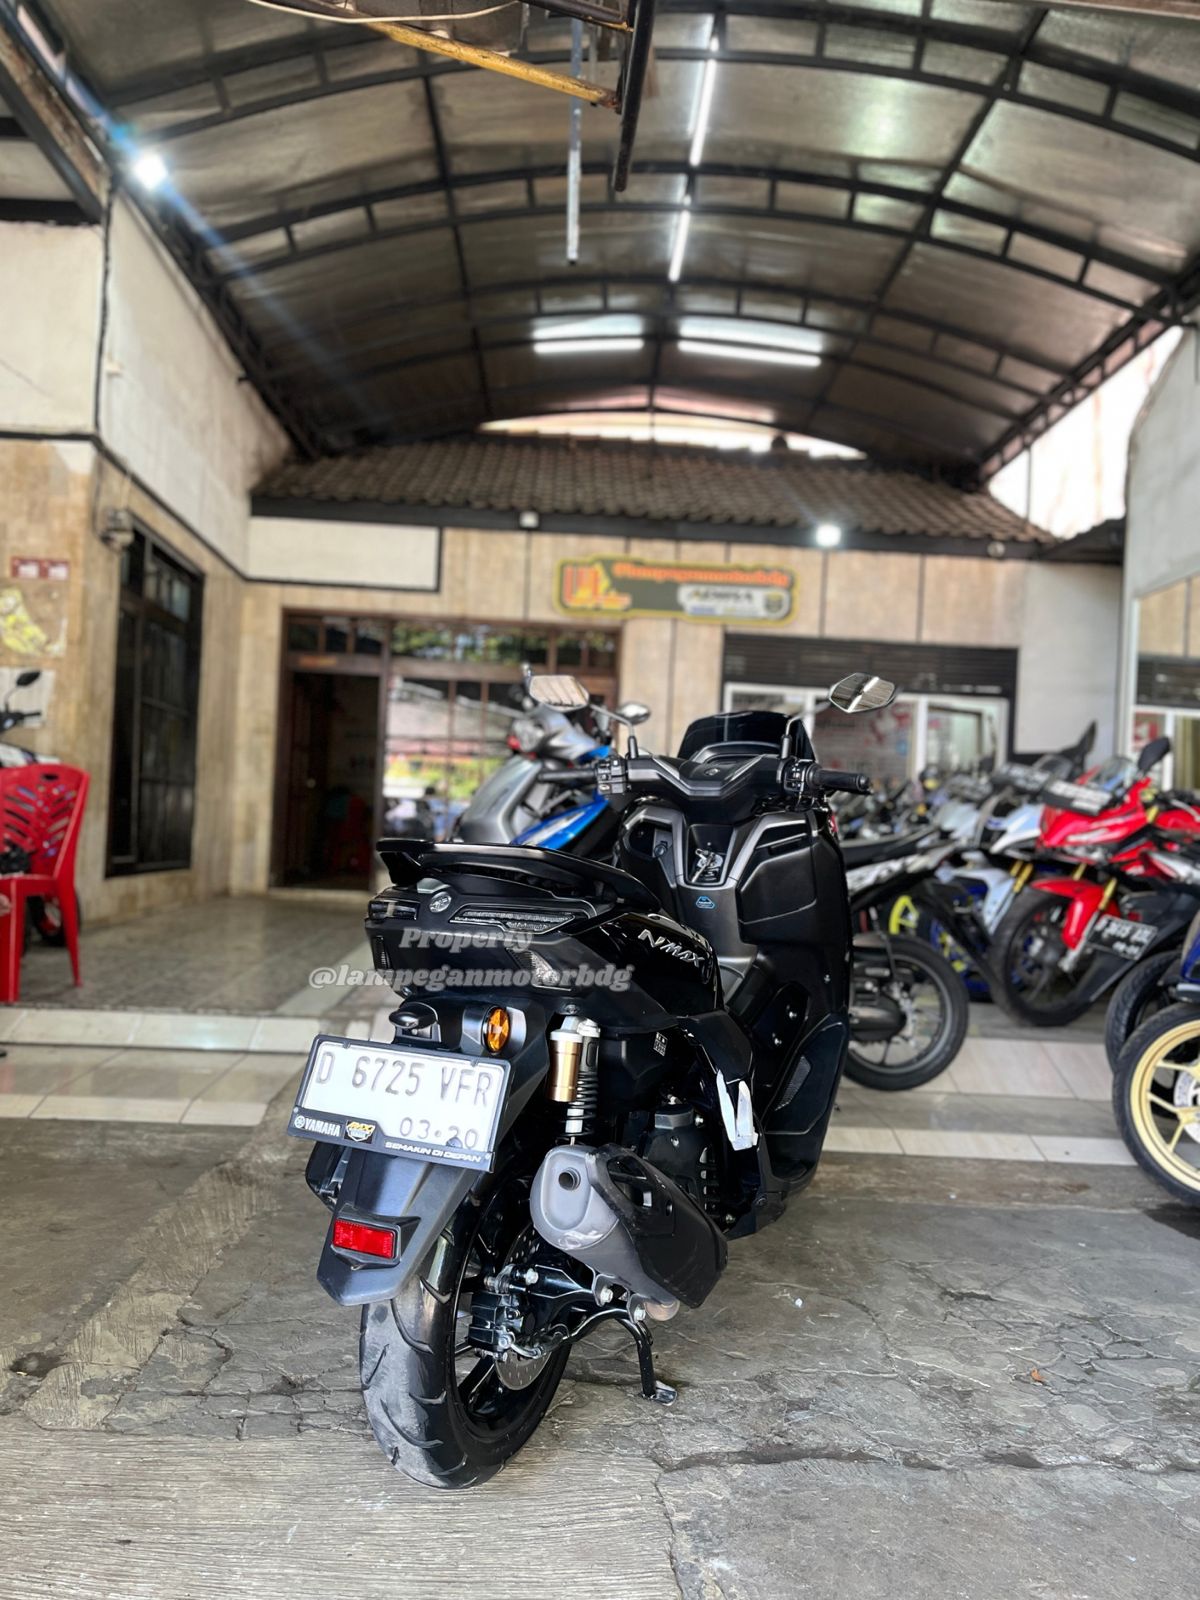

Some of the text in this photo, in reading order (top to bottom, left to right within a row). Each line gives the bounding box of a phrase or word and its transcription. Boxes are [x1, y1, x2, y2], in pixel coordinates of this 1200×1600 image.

[637, 928, 706, 968] NMAX
[315, 1051, 494, 1107] D 6725 VFR
[304, 1117, 341, 1137] YAMAHA
[385, 1141, 482, 1163] SEMAKIN DI DEPAN
